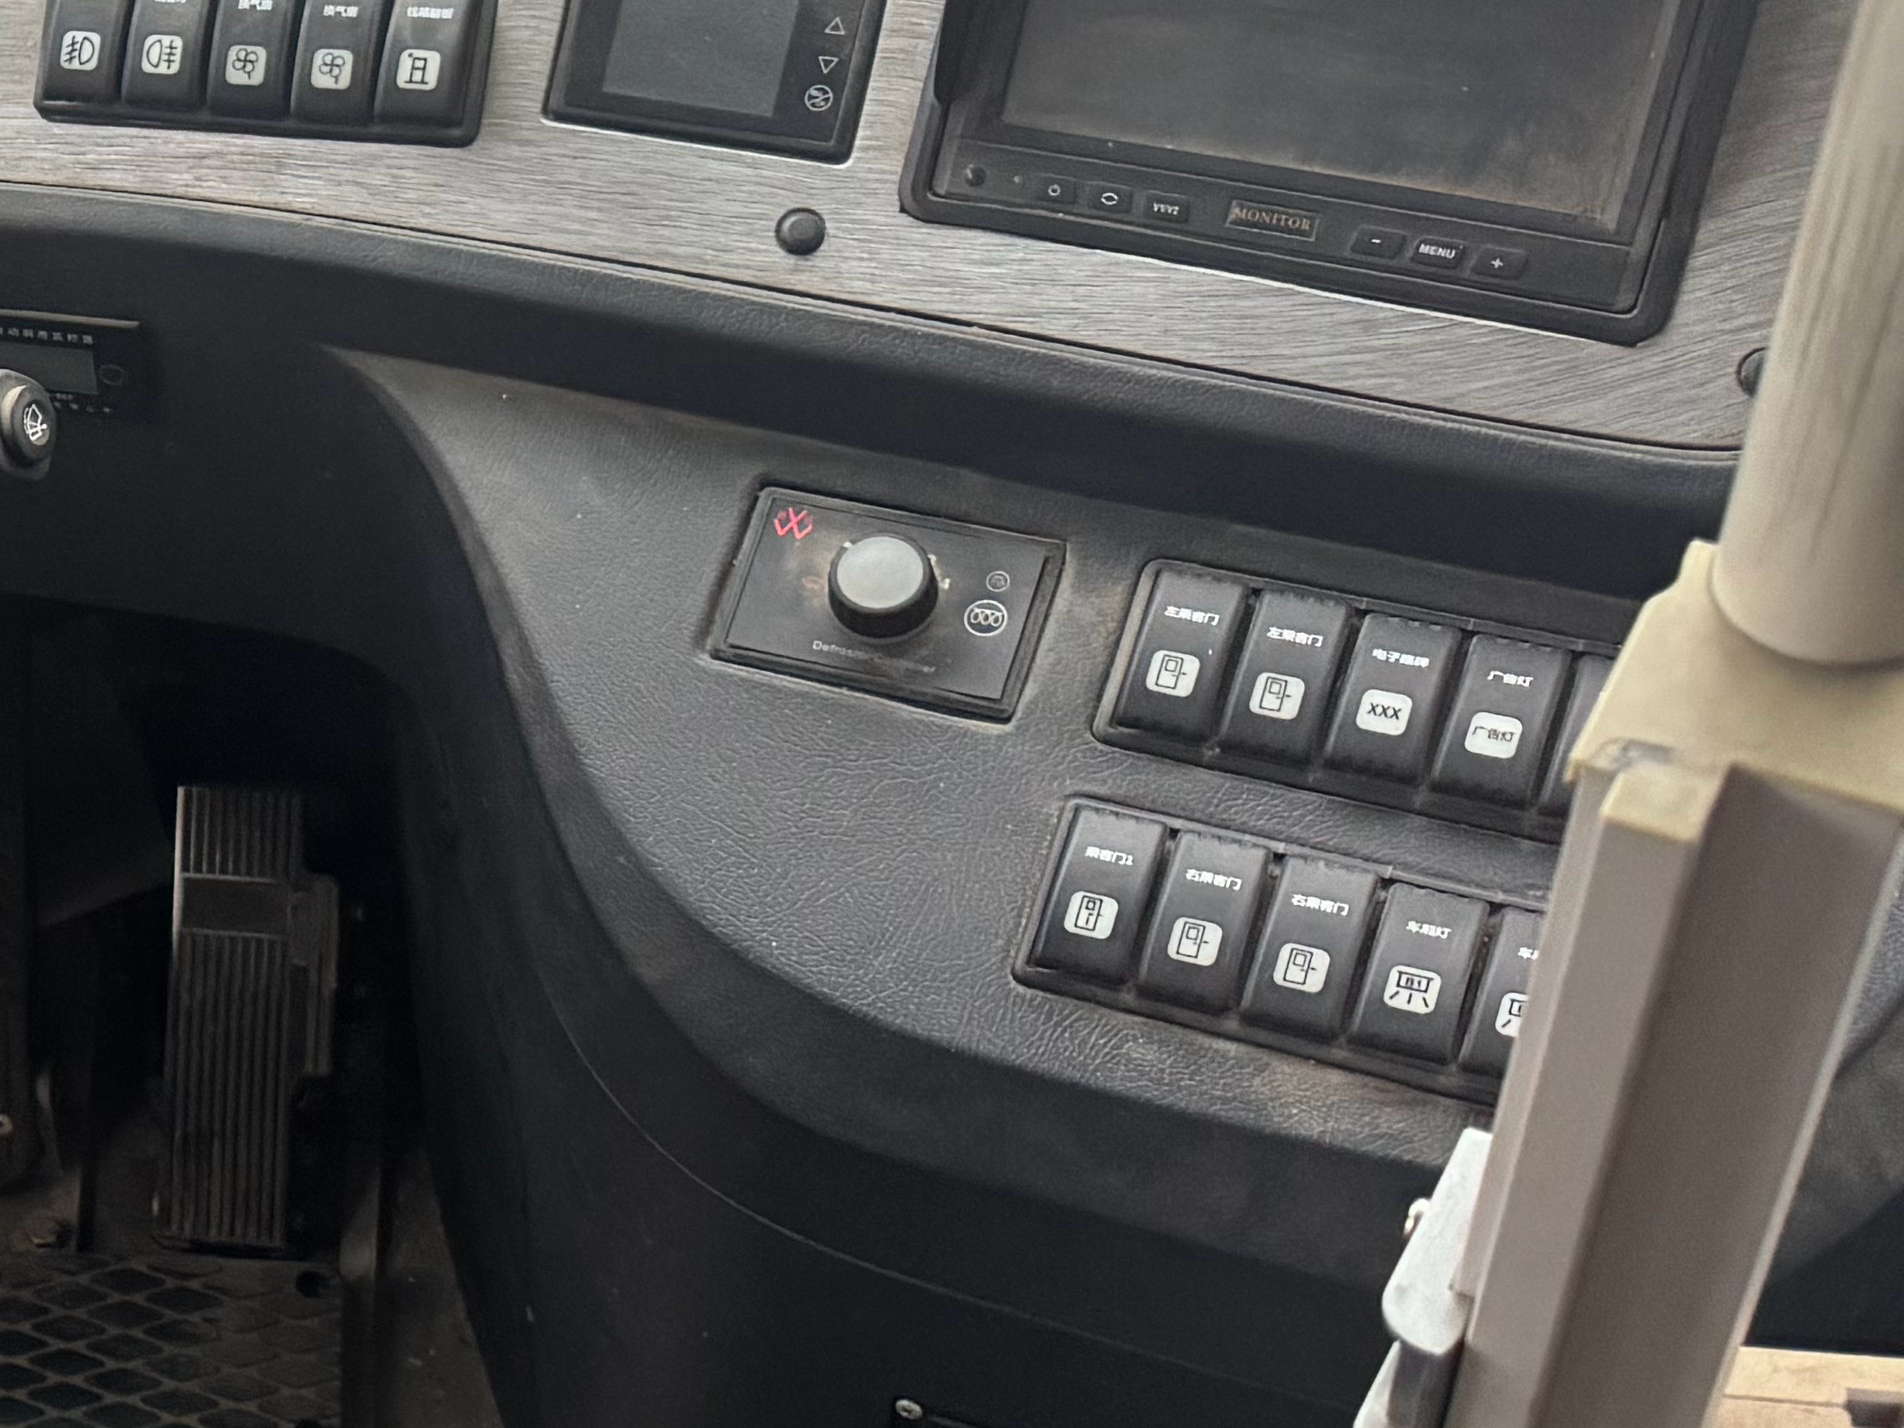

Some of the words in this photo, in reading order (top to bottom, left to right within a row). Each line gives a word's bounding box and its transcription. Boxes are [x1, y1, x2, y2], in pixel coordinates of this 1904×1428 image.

[1234, 205, 1311, 230] MONITOR
[1419, 243, 1456, 259] MENU
[1367, 703, 1402, 719] XXX
[1471, 725, 1515, 741] 广告灯
